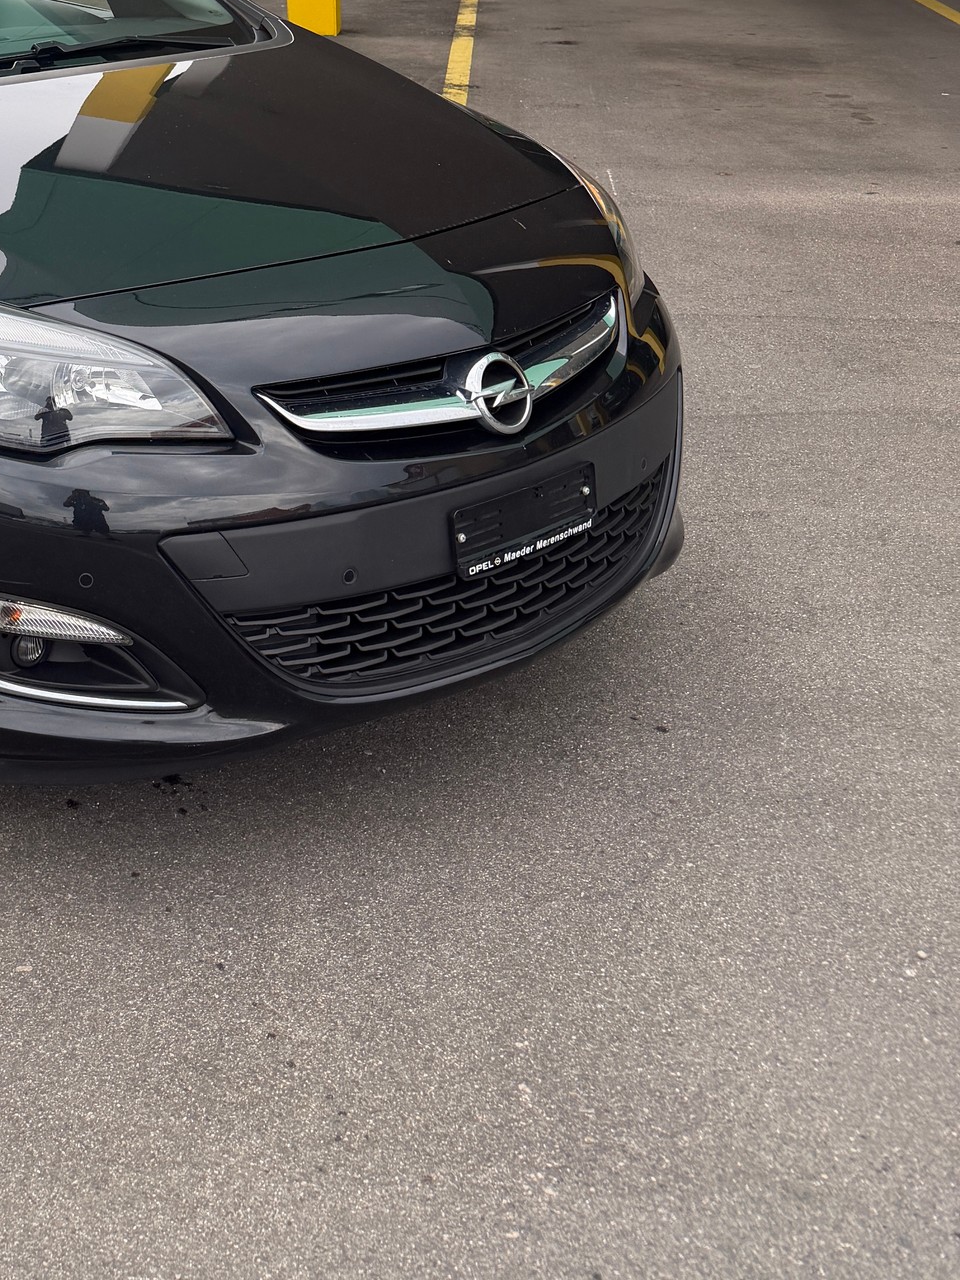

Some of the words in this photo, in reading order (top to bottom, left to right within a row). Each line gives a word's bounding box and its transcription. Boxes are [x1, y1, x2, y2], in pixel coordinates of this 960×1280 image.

[468, 560, 494, 576] OPEL
[503, 545, 535, 563] Maeder
[536, 518, 592, 550] Merenschwand
